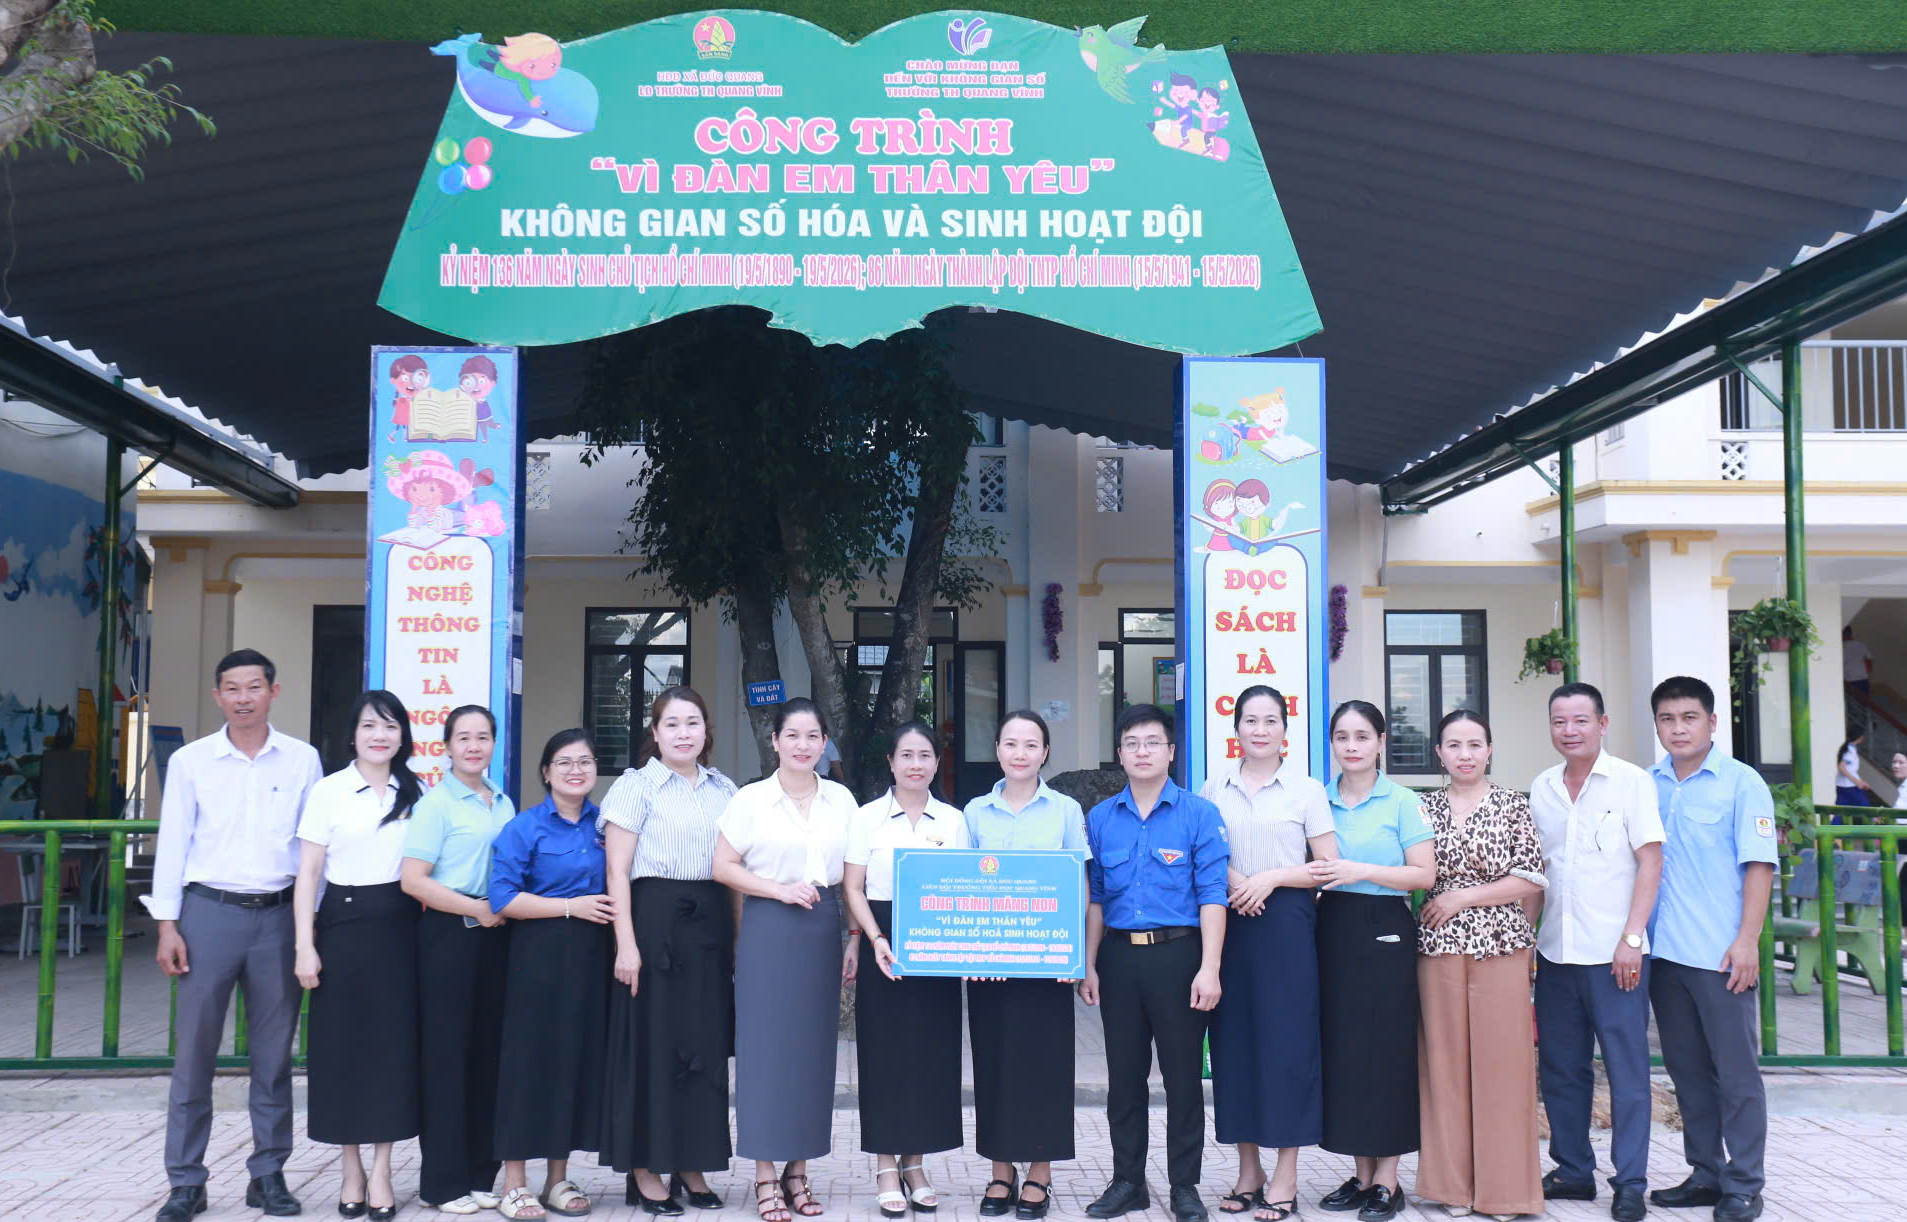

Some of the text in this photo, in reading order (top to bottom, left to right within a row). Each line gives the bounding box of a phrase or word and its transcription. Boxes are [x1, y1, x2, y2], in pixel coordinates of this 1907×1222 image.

[657, 69, 763, 82] HĐĐ XÃ ĐỨC QUANG
[906, 59, 1019, 72] CHÀO MỪNG BẠN
[915, 72, 937, 84] VỚI
[941, 73, 987, 85] KHÔNG
[990, 75, 1023, 85] GIAN
[1026, 72, 1046, 85] SỐ
[655, 83, 699, 97] TRƯỜNG
[700, 86, 715, 97] TH
[717, 86, 753, 97] QUANG
[885, 86, 940, 98] TRƯỜNG
[942, 87, 960, 98] TH
[963, 87, 1009, 99] QUANG
[695, 107, 1013, 155] CÔNG TRÌNH
[673, 159, 769, 194] ĐÀN
[784, 164, 854, 194] EM
[868, 160, 988, 194] THÂN
[501, 198, 1203, 244] KHÔNG GIAN SỐ HÓA VÀ SINH HOẠT ĐỘI
[441, 243, 457, 287] KỶ
[458, 248, 490, 294] NIỆM
[492, 254, 513, 287] 136
[515, 248, 543, 287] NĂM
[544, 248, 576, 287] NGÀY
[577, 254, 606, 287] SINH
[608, 244, 632, 287] CHỦ
[633, 254, 659, 294] TỊCH
[661, 243, 678, 287] HỒ
[679, 248, 700, 287] CHÍ
[701, 254, 732, 287] MINH
[734, 254, 794, 289] (19/5/1890
[795, 268, 801, 277] -
[802, 254, 866, 291] 19/5/2026);
[867, 254, 882, 287] 86
[884, 248, 911, 287] NĂM
[913, 248, 944, 287] NGÀY
[945, 248, 983, 287] THÀNH
[985, 248, 1007, 294] LẬP
[1008, 248, 1029, 294] ĐỘI
[1030, 255, 1059, 287] TNTP
[1078, 248, 1099, 287] CHÍ
[1100, 255, 1131, 287] MINH
[1133, 254, 1191, 290] (15/5/1941
[1193, 268, 1200, 277] -
[1201, 254, 1260, 290] 15/5/2026)
[408, 551, 474, 571] CÔNG
[1224, 569, 1287, 596] ĐỌC
[407, 582, 474, 606] NGHỆ
[398, 613, 480, 633] THÔNG
[1215, 606, 1297, 632] SÁCH
[418, 648, 459, 664] TIN
[1236, 647, 1276, 674] LÀ
[422, 675, 453, 695] LÀ
[1215, 695, 1299, 717] CH
[920, 894, 1058, 913] CÔNG TRÌNH MĂNG NON
[977, 917, 990, 925] EM
[992, 915, 1017, 926] THÂN
[909, 927, 942, 937] KHÔNG
[944, 928, 966, 937] GIAN
[968, 926, 981, 937] SỐ
[1004, 929, 1025, 938] SINH
[1026, 930, 1051, 941] HOẠT
[1052, 928, 1069, 940] ĐỘI
